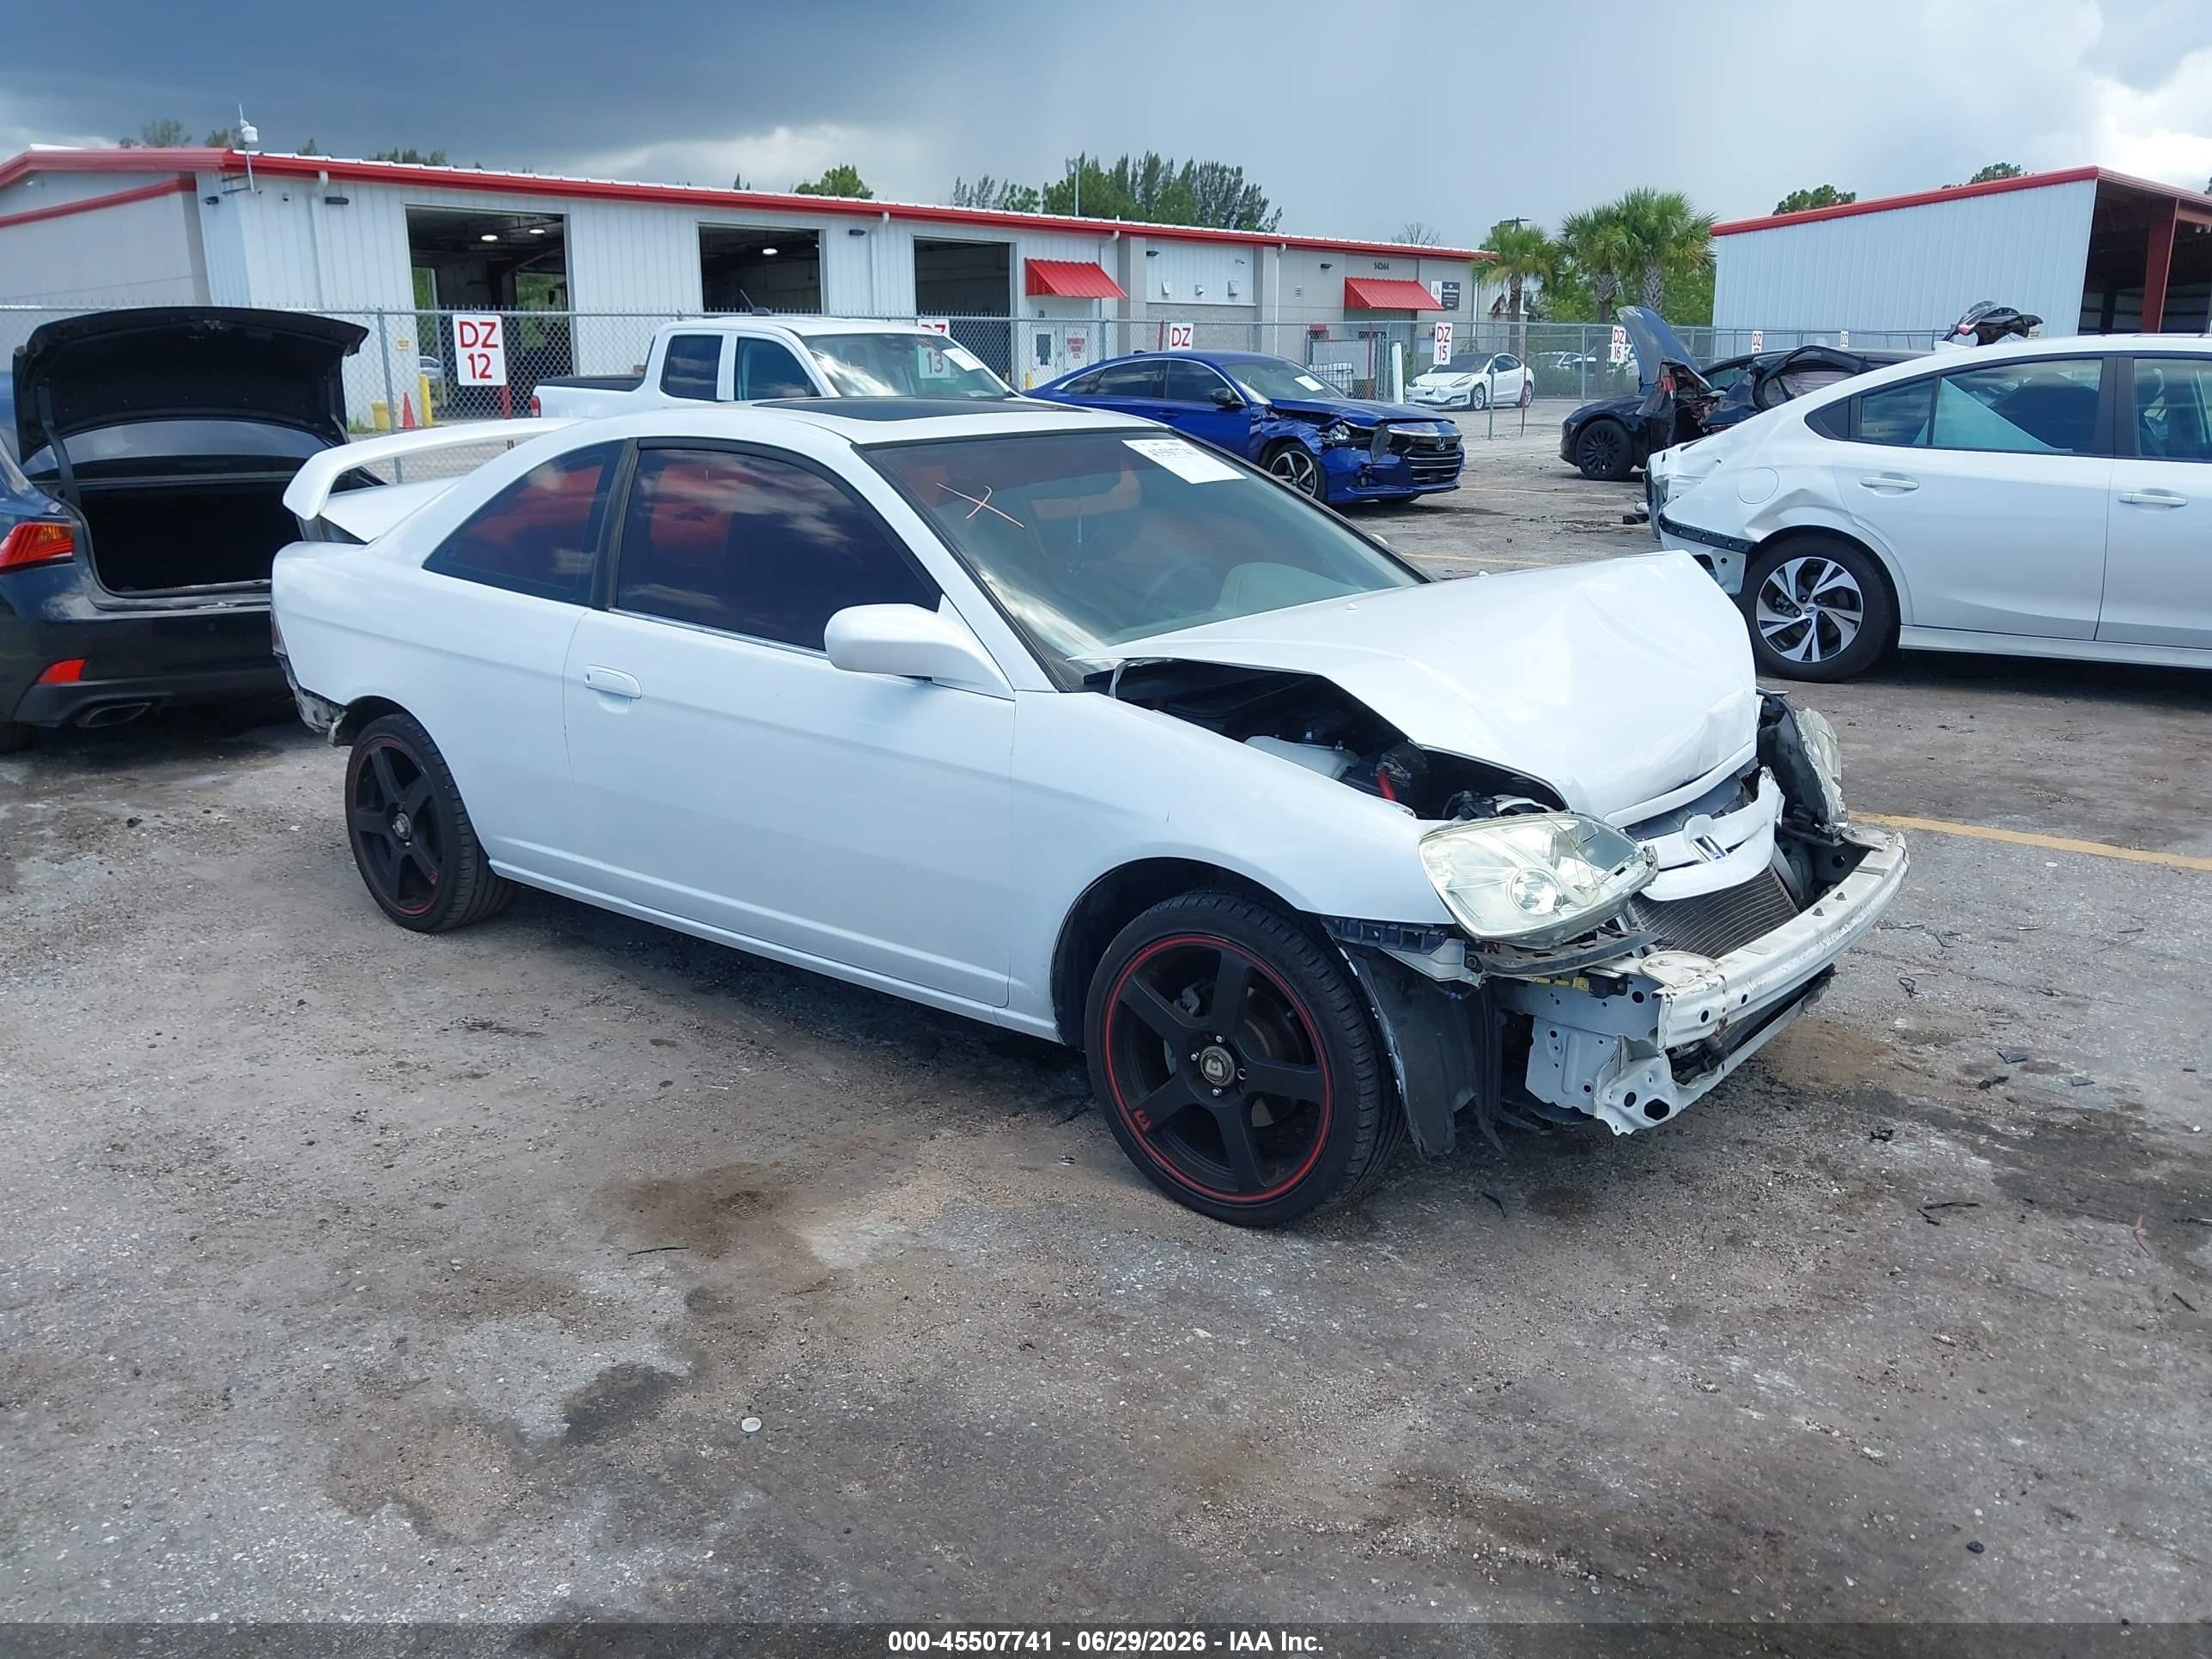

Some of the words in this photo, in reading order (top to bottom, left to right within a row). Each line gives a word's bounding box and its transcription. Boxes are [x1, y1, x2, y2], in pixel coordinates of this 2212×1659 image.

[459, 321, 499, 348] DZ
[1171, 327, 1191, 347] DZ
[1437, 326, 1451, 343] DZ
[1613, 329, 1626, 344] DZ
[1753, 333, 1761, 346] DZ
[1841, 333, 1848, 345] DZ
[1438, 345, 1448, 362] 15
[1614, 346, 1621, 360] 16
[467, 353, 493, 380] 12
[926, 351, 944, 374] 13
